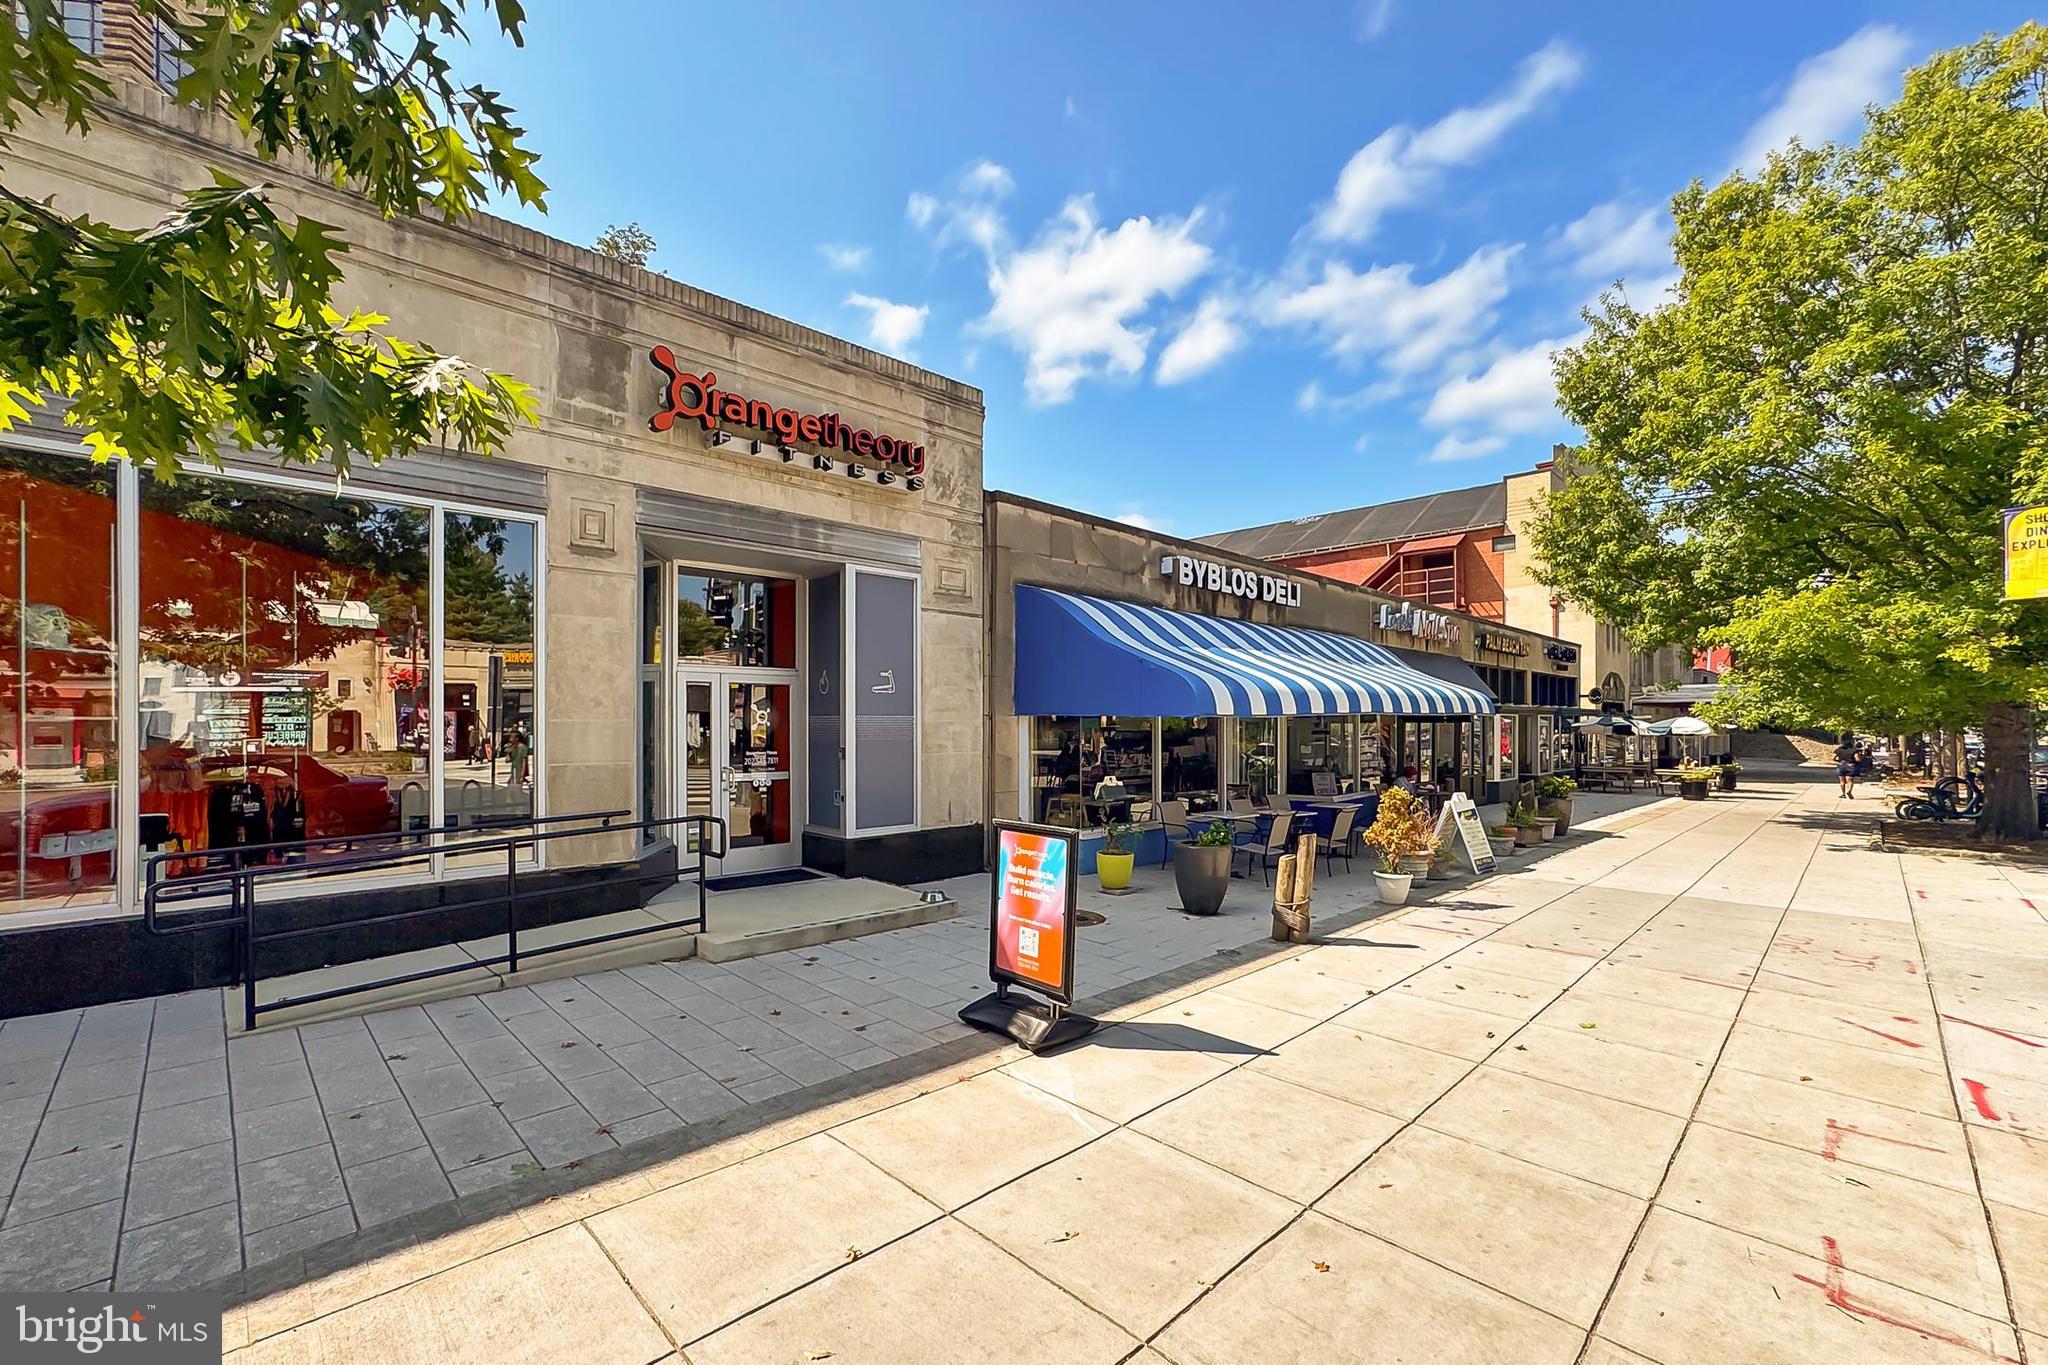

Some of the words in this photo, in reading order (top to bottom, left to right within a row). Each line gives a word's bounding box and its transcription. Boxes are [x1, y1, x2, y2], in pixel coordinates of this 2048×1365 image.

[713, 429, 926, 492] FITNESS
[2012, 539, 2048, 552] EXPL
[1179, 556, 1258, 600] BYBLOS
[1262, 575, 1301, 608] DELI
[1485, 633, 1501, 651] PALM
[1502, 636, 1520, 655] BEACH
[1008, 863, 1027, 875] Build
[1006, 872, 1025, 886] Burn
[1010, 885, 1024, 896] Get
